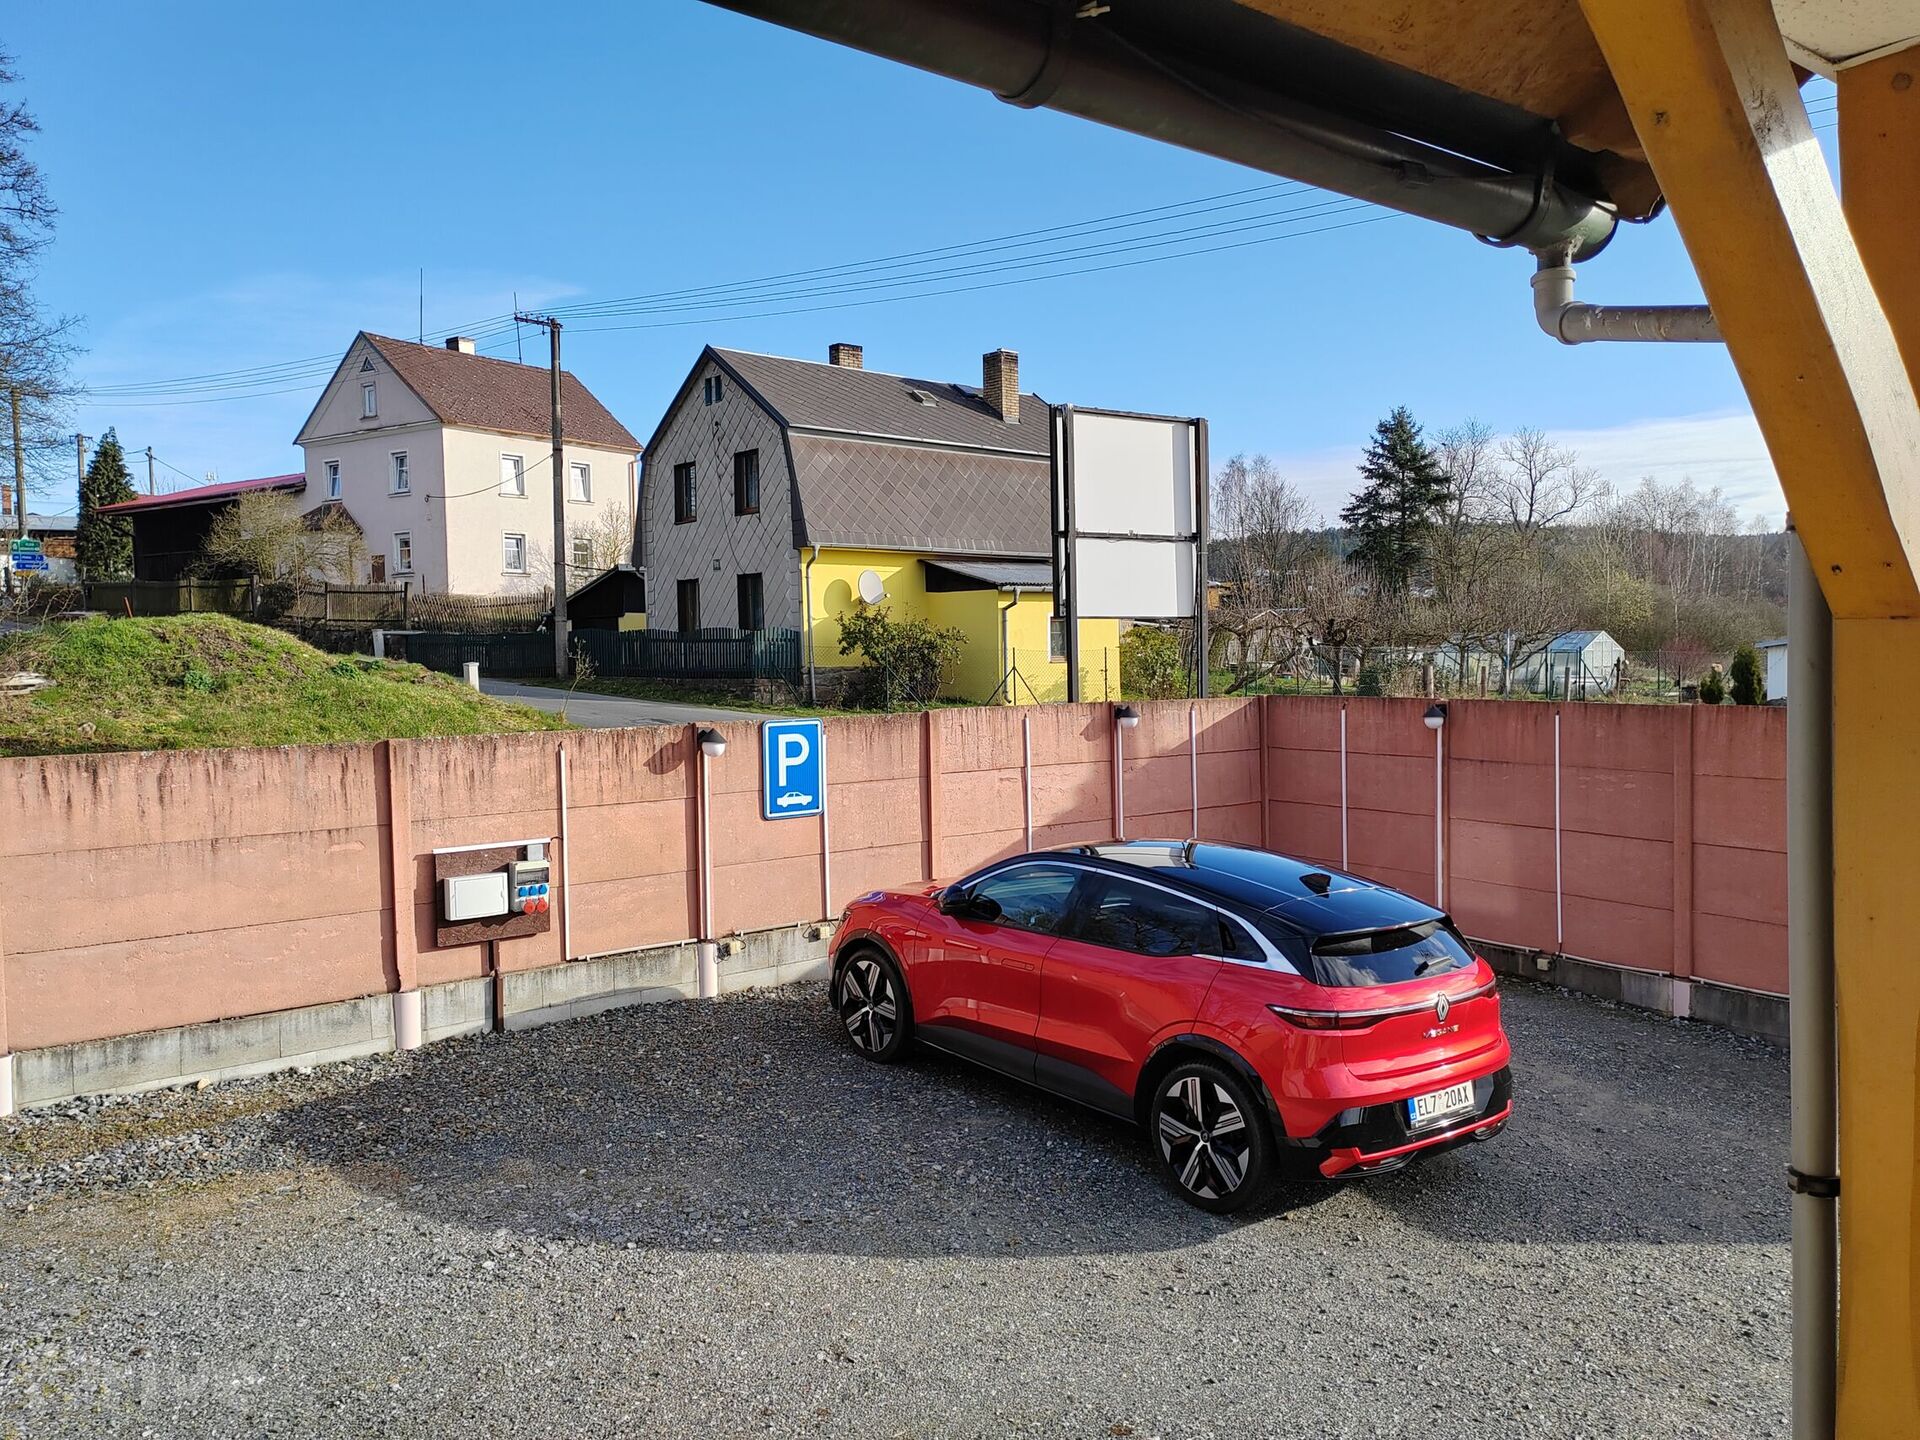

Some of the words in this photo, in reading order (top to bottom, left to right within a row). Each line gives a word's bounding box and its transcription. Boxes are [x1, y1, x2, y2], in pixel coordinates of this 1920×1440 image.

[778, 733, 810, 787] P
[1417, 1095, 1437, 1117] EL7
[1444, 1085, 1470, 1109] 20AX
